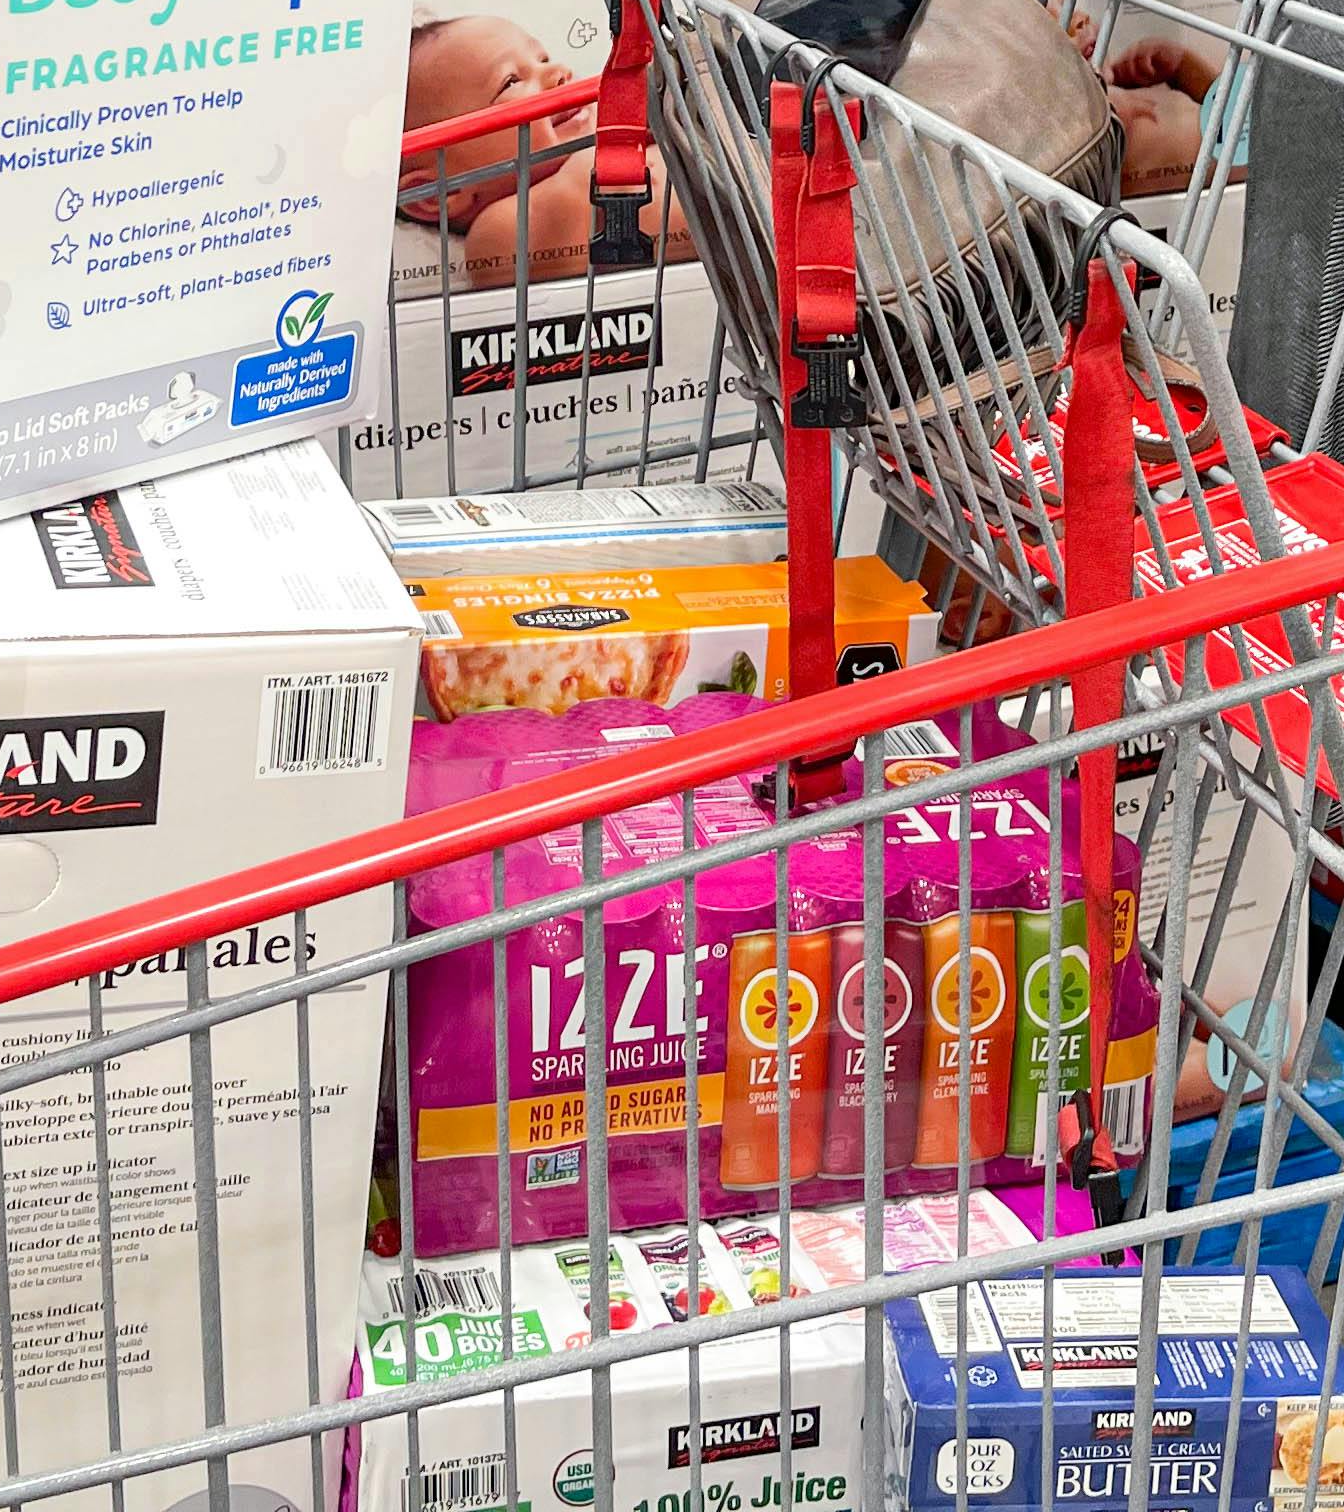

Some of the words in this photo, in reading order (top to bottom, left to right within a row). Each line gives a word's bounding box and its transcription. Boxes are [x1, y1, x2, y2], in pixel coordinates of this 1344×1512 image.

[5, 33, 258, 94] FRAGRANCE
[273, 18, 365, 60] FREE
[0, 110, 92, 140] Clinically
[98, 99, 169, 126] Proven
[173, 95, 196, 114] To
[201, 89, 243, 110] Help
[111, 133, 153, 156] Skin
[92, 170, 225, 208] Hypoallergenic
[88, 231, 114, 250] No
[119, 215, 196, 245] Chlorine,
[279, 194, 323, 215] Dyes,
[86, 243, 174, 275] Parabens
[178, 242, 196, 257] or
[201, 223, 292, 253] Phthalates
[83, 286, 176, 317] Ultra-soft,
[180, 262, 284, 300] plant-based
[287, 252, 332, 275] fibers
[240, 373, 297, 399] Naturally
[299, 359, 347, 385] Derived
[267, 356, 299, 375] made
[301, 349, 324, 367] with
[13, 415, 46, 442] Lid
[47, 405, 91, 434] Soft
[93, 392, 151, 423] Packs
[268, 677, 295, 689] ITM.
[338, 671, 389, 685] 1481672
[530, 1104, 554, 1123] NO
[628, 1086, 686, 1107] SUGAR
[529, 1123, 554, 1143] NO
[971, 1461, 996, 1473] OZ
[1060, 1445, 1113, 1459] SALTED
[1168, 1442, 1221, 1456] CREAM
